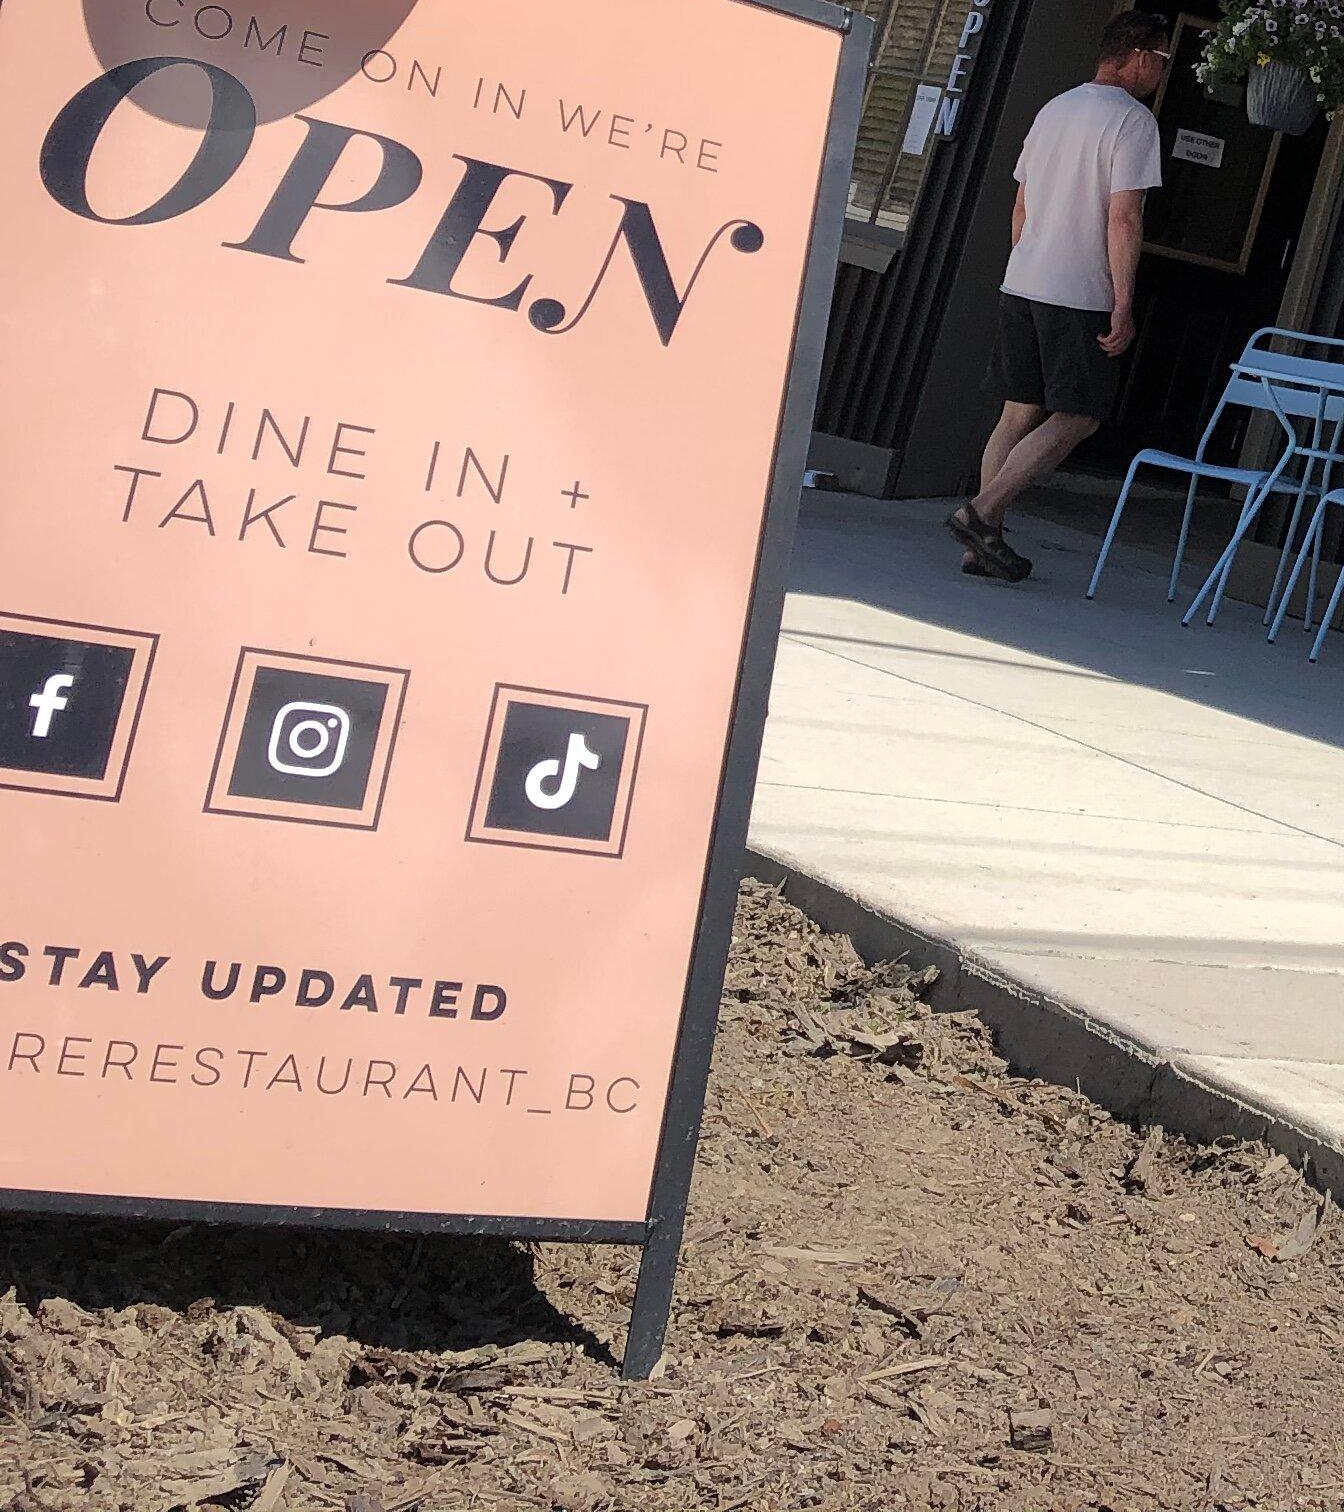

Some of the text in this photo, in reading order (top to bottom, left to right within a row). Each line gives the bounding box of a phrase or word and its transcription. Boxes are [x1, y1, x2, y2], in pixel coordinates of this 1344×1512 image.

[360, 49, 442, 98] ON
[473, 77, 527, 120] IN
[558, 99, 724, 174] WE'RE
[38, 54, 765, 348] OPEN
[141, 387, 377, 479] DINE
[425, 441, 510, 505] IN
[113, 464, 594, 595] TAKE OUT
[0, 941, 509, 1022] STAY UPDATED
[8, 1032, 641, 1116] RERESTAURANT_BC
